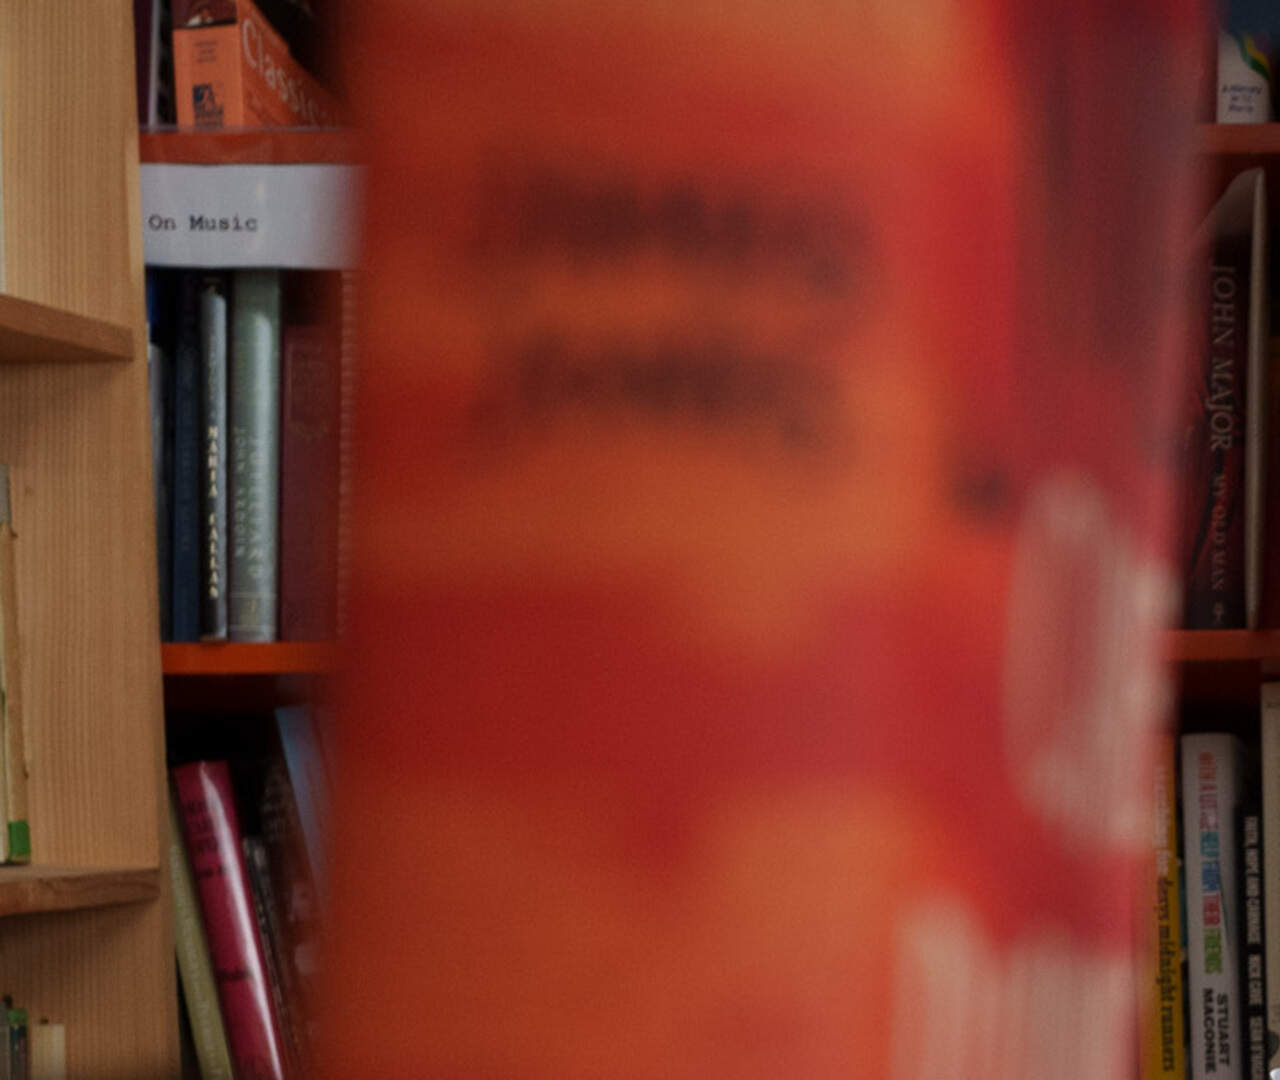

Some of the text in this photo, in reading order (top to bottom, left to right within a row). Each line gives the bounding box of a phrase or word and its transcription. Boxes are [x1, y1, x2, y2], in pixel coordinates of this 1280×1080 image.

[148, 213, 260, 232] On Music
[1204, 264, 1236, 453] JOHN MAJOR
[1156, 925, 1179, 1002] midnight
[1160, 1005, 1179, 1073] runners
[1203, 988, 1217, 1073] MACONIE
[1216, 993, 1231, 1066] STUART
